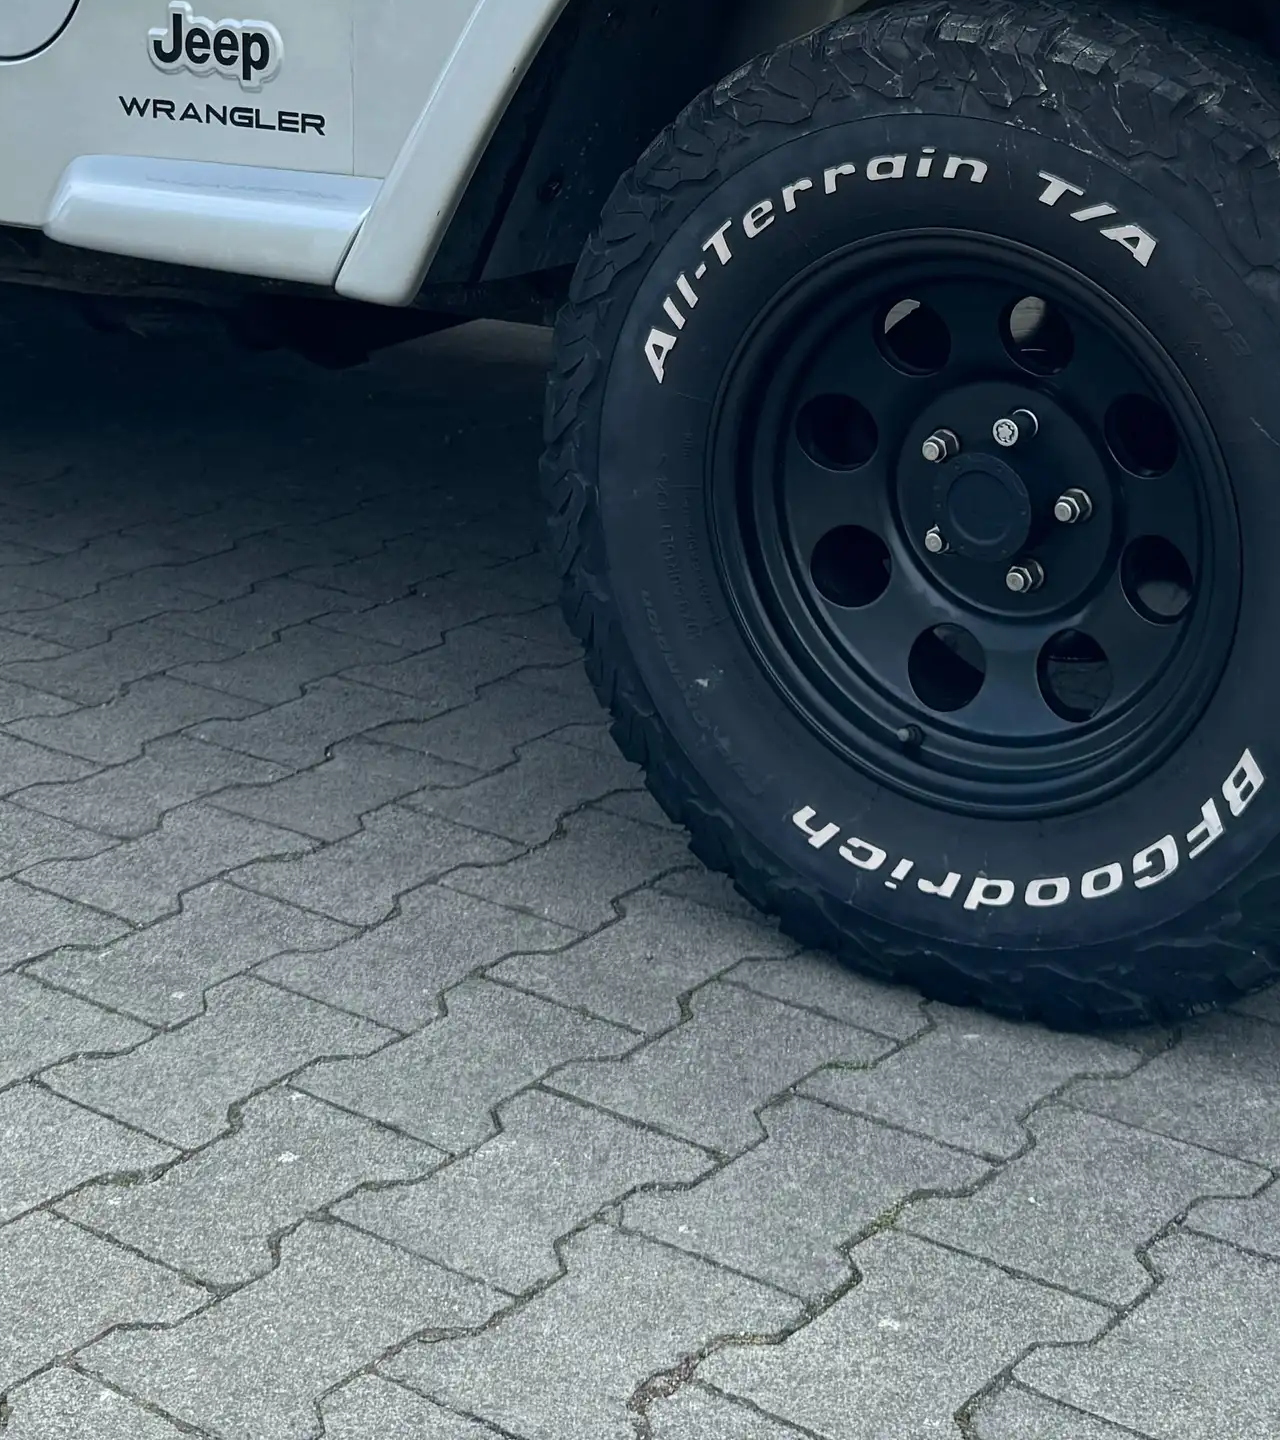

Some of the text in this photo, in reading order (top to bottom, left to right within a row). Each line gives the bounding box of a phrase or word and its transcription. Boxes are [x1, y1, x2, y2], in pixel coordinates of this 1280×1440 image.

[153, 13, 270, 81] Jeep
[119, 95, 326, 136] WRANGLER
[643, 147, 1160, 384] All-Terrain T/A
[792, 747, 1267, 912] BFGoodrich
